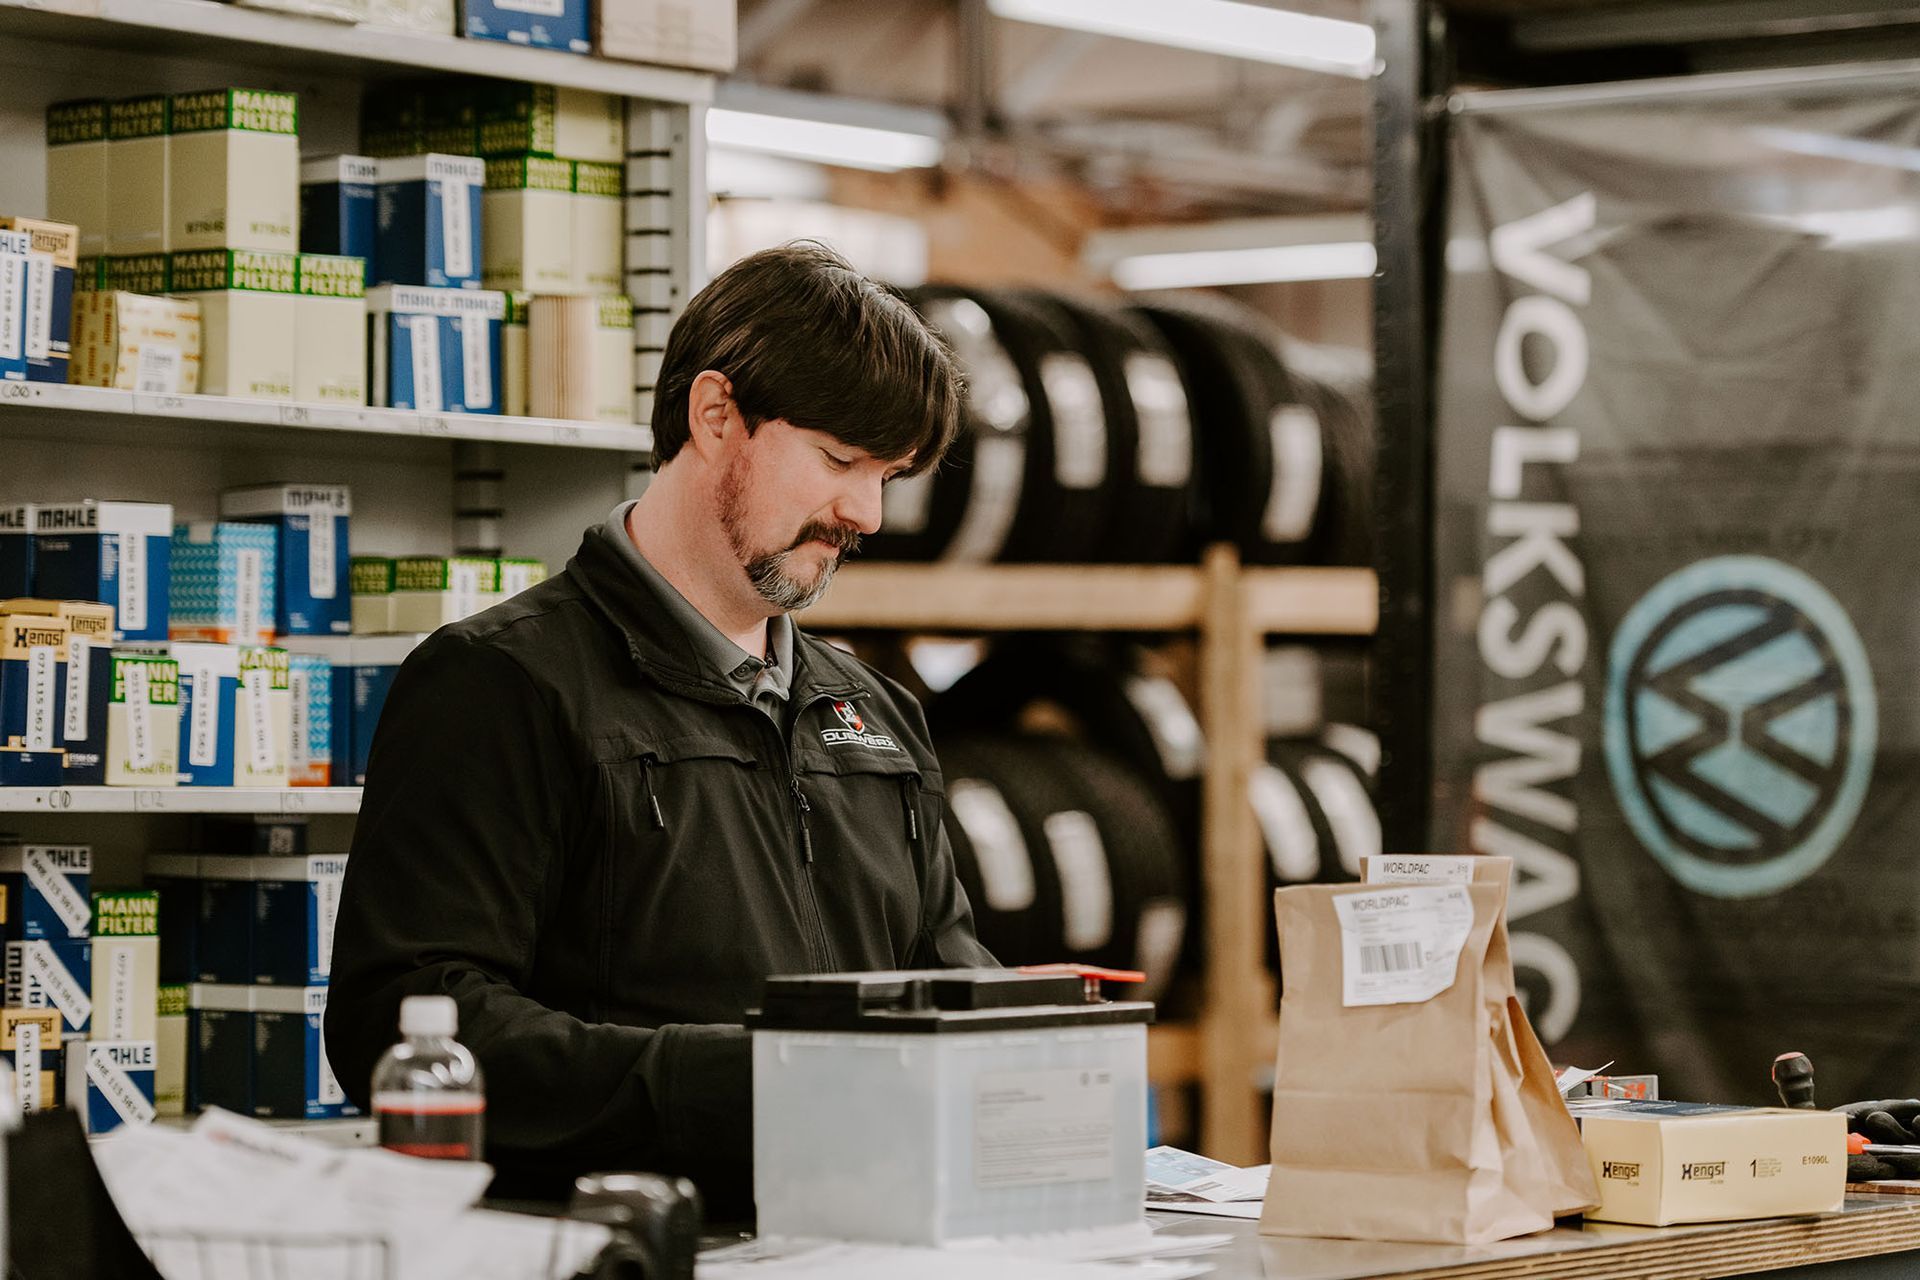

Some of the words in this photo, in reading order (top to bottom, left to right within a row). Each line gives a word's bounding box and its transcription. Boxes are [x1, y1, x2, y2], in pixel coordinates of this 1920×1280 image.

[0, 236, 27, 254] HLE
[23, 228, 69, 252] engst
[37, 508, 97, 528] MAHLE
[65, 614, 107, 634] engst
[1471, 191, 1598, 1045] VOLKSWAG
[13, 627, 66, 648] Hengst
[115, 660, 177, 682] MNN
[114, 680, 177, 703] FER
[1383, 862, 1431, 875] WORLDPAC
[98, 897, 158, 916] MANN
[1352, 894, 1410, 912] WORLDPAC
[97, 915, 157, 934] FILTER
[7, 1017, 53, 1037] Hst
[22, 1093, 33, 1114] 56
[1602, 1161, 1640, 1180] Hengst
[1681, 1161, 1726, 1180] Hengst
[1750, 1159, 1757, 1178] 1
